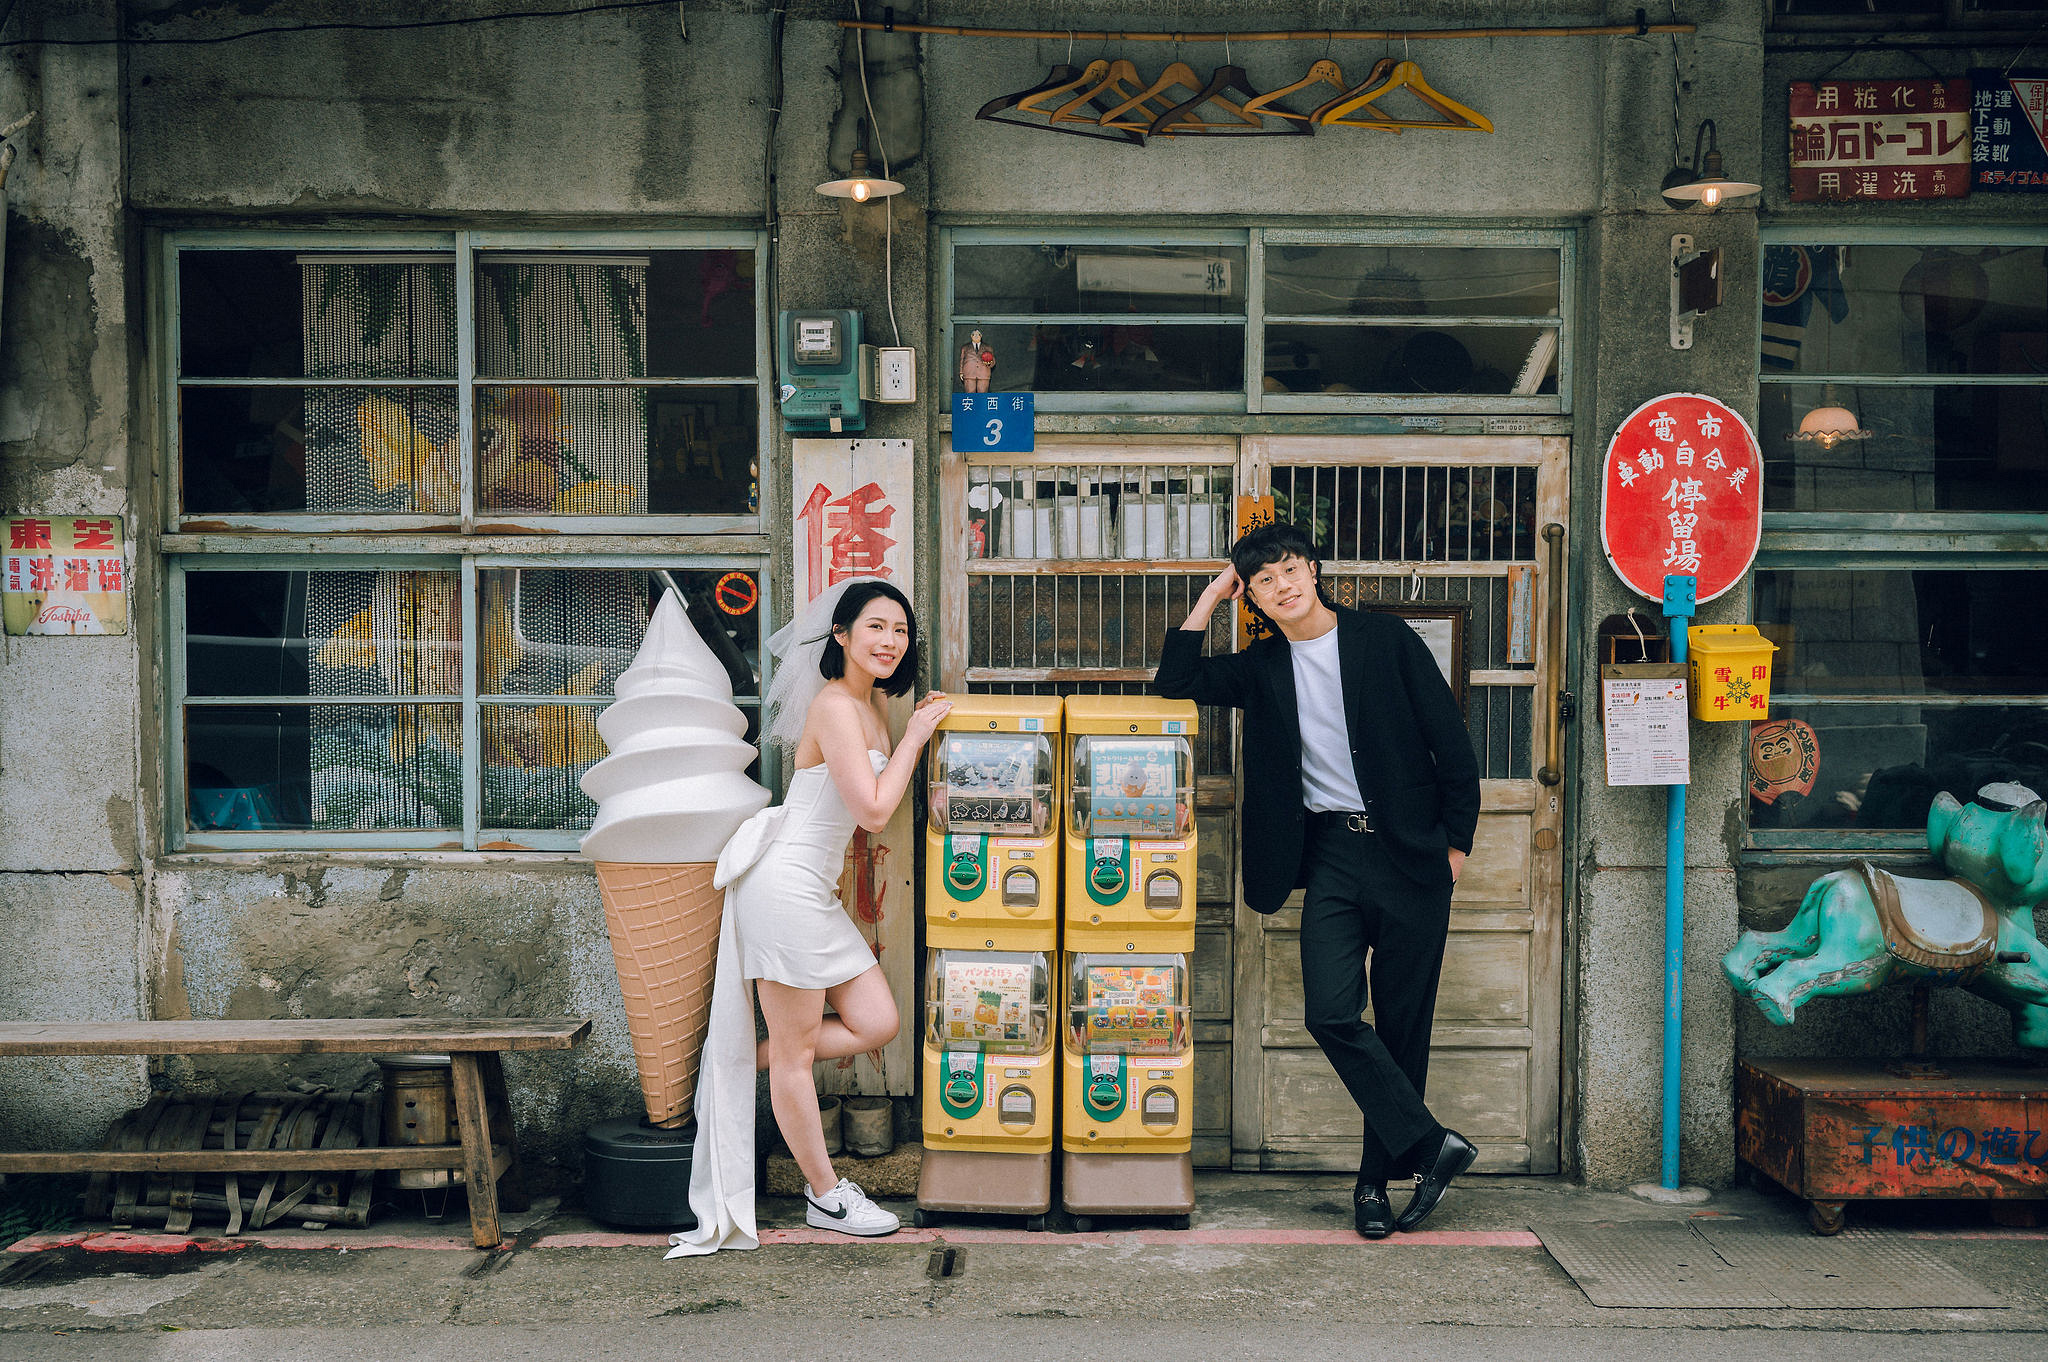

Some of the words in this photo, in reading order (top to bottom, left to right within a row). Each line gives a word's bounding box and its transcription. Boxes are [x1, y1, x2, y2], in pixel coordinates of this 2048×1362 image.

[1973, 90, 1993, 162] 地下足袋
[1992, 90, 2013, 162] 運動靴
[961, 395, 1025, 412] 安西街
[983, 418, 1004, 446] 3
[10, 518, 115, 550] 東芝
[1661, 475, 1707, 574] 停留場
[29, 557, 122, 592] 洗濯機
[38, 605, 91, 624] Toshiba
[1713, 665, 1767, 683] 雪印
[1713, 694, 1766, 711] 牛乳
